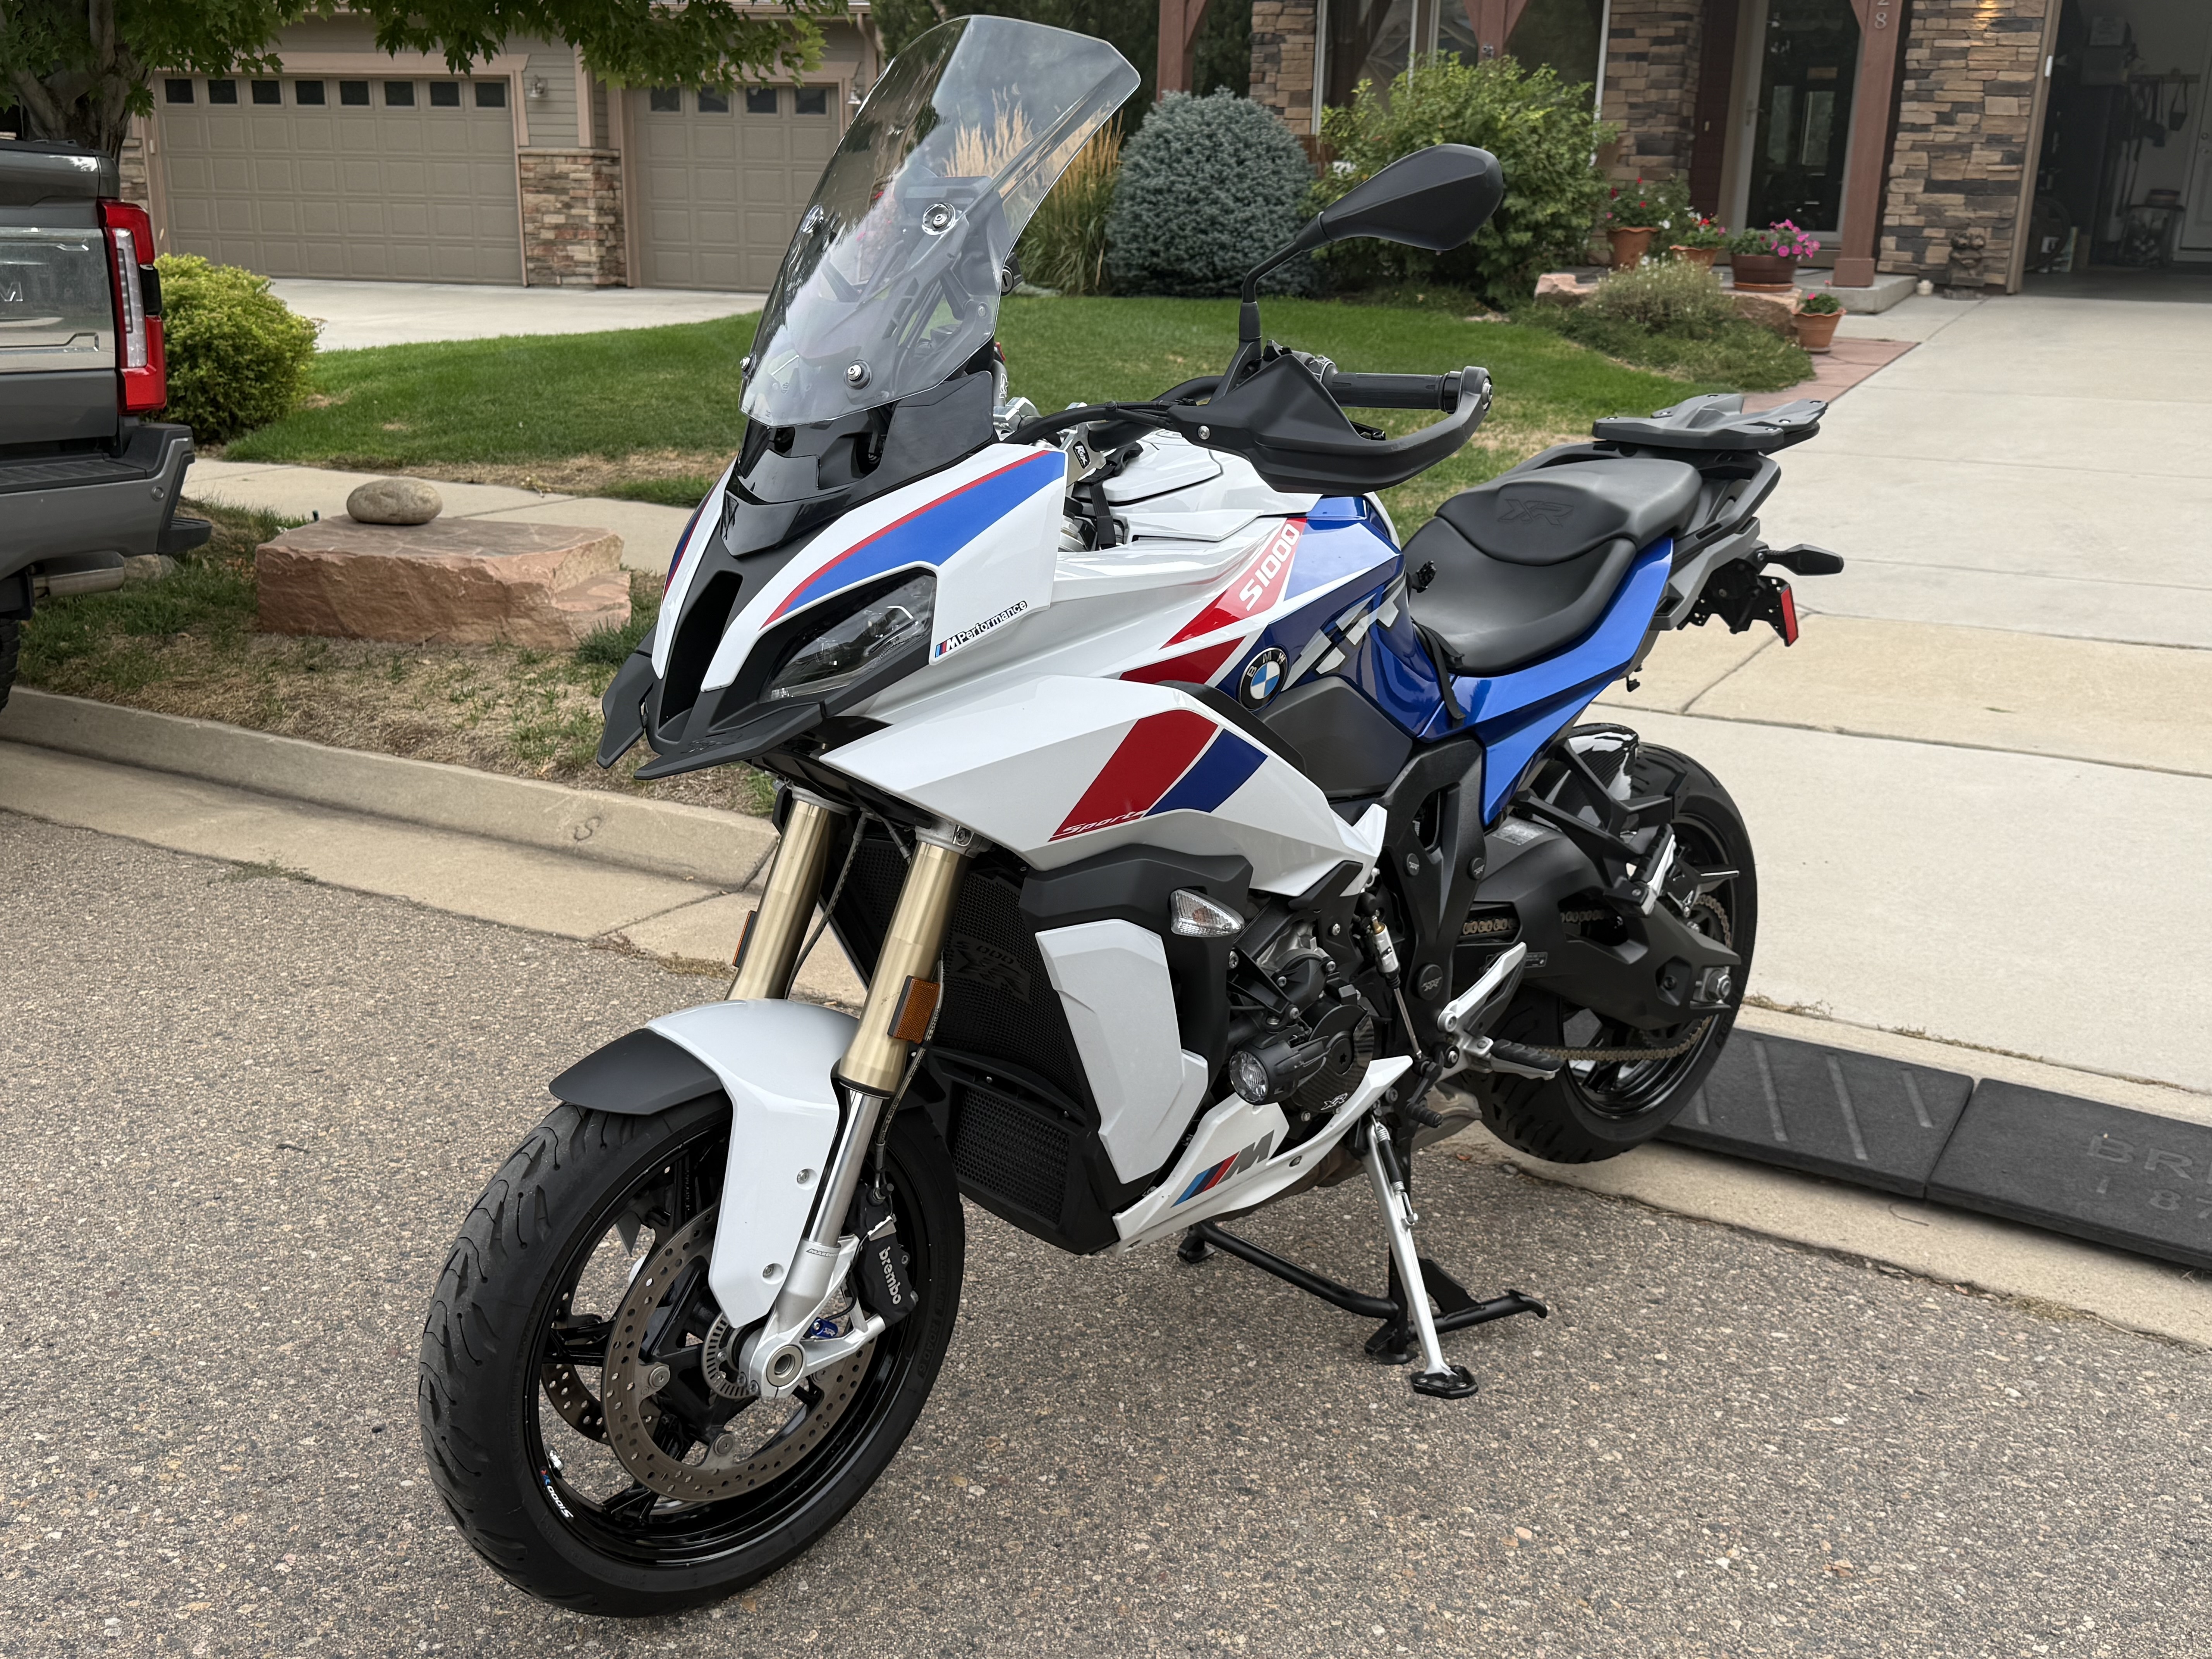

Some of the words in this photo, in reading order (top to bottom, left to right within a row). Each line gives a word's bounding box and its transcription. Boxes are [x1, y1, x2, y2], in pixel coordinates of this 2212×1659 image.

[1497, 499, 1574, 527] XR
[1239, 523, 1300, 611] S1000
[957, 601, 1027, 643] Performance
[1247, 651, 1286, 678] BMW
[1321, 1092, 1348, 1110] XR
[1216, 1129, 1274, 1185] M
[2087, 1135, 2212, 1184] BR
[879, 1246, 901, 1305] brembo
[547, 1486, 574, 1518] S1000
